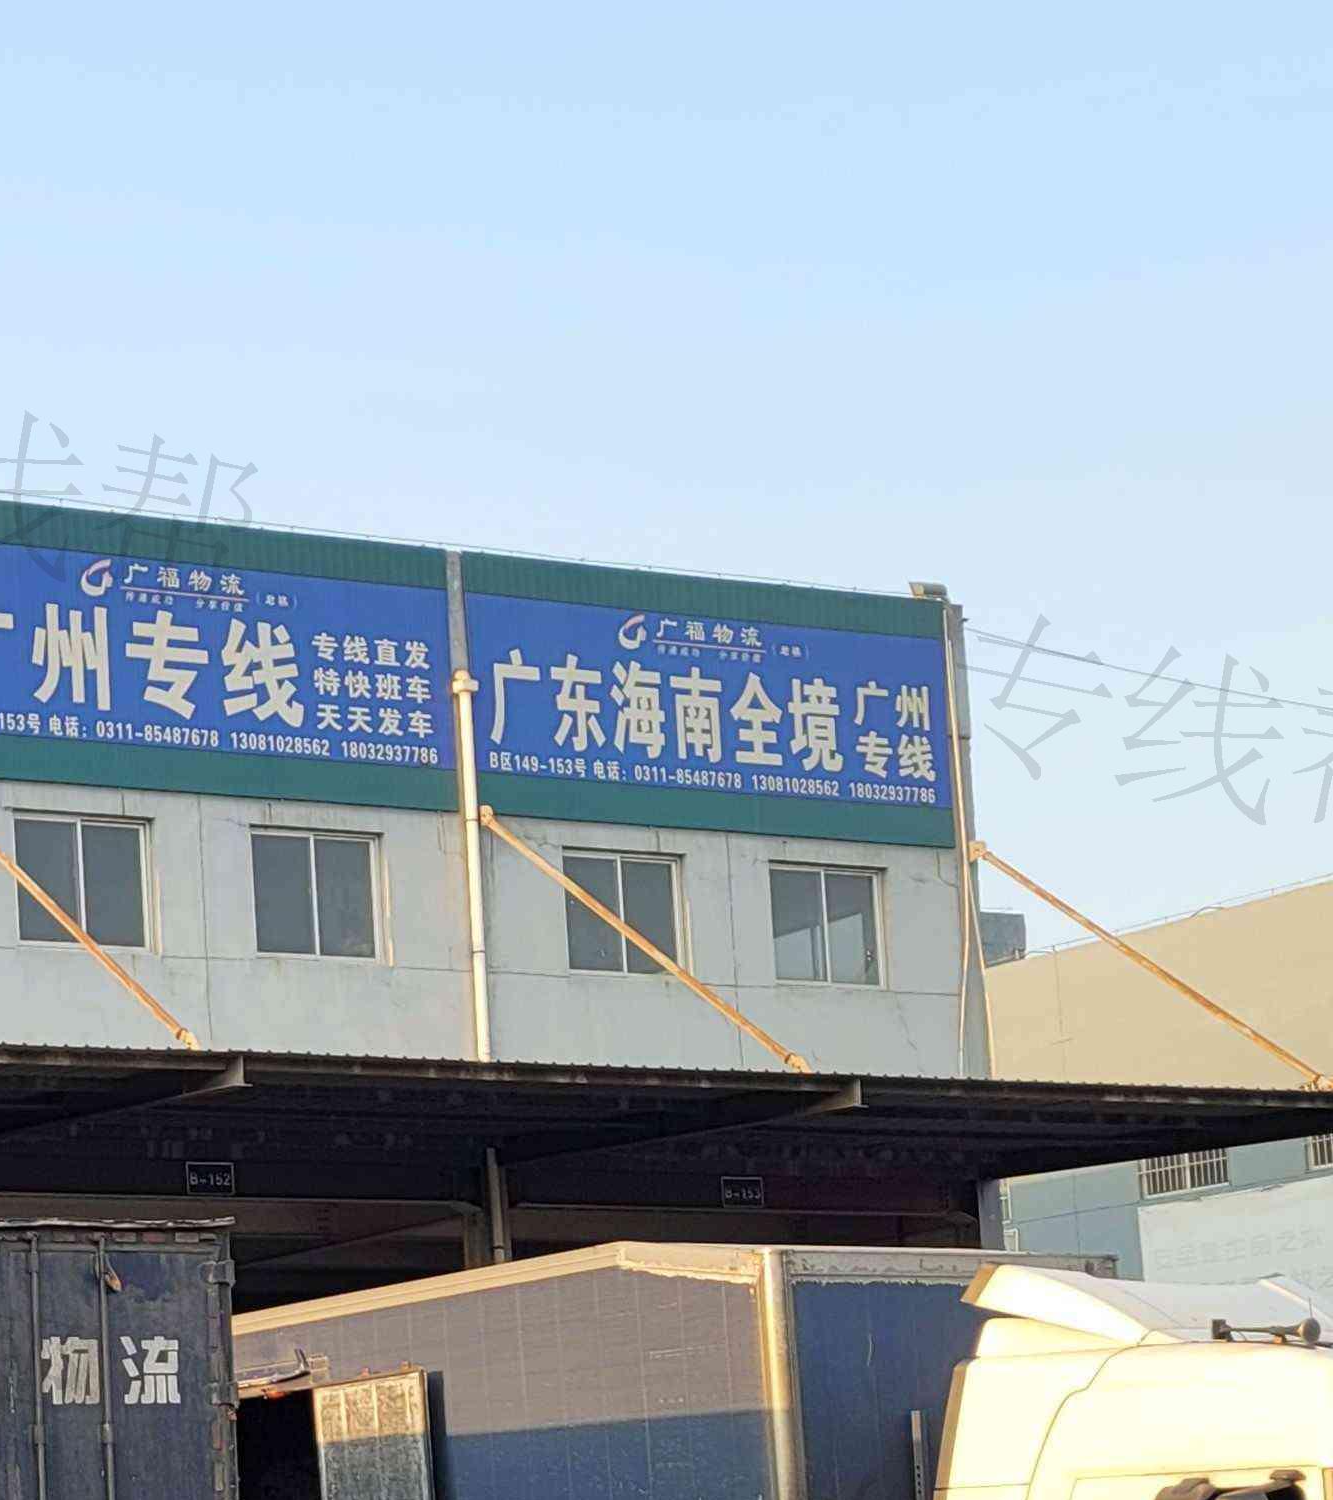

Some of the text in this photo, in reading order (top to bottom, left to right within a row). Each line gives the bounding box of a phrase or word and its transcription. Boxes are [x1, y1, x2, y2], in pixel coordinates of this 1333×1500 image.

[123, 562, 247, 597] 广福物流
[312, 631, 431, 670] 专线直发
[656, 616, 763, 649] 广福物流
[313, 667, 431, 704] 特快班车
[314, 702, 435, 740] 天天发车
[490, 648, 844, 774] 广东海南全境
[854, 681, 931, 732] 广州
[96, 719, 219, 749] 0311-85487678
[230, 732, 331, 757] 13081028562
[340, 740, 439, 766] 18032937786
[855, 731, 937, 783] 专线
